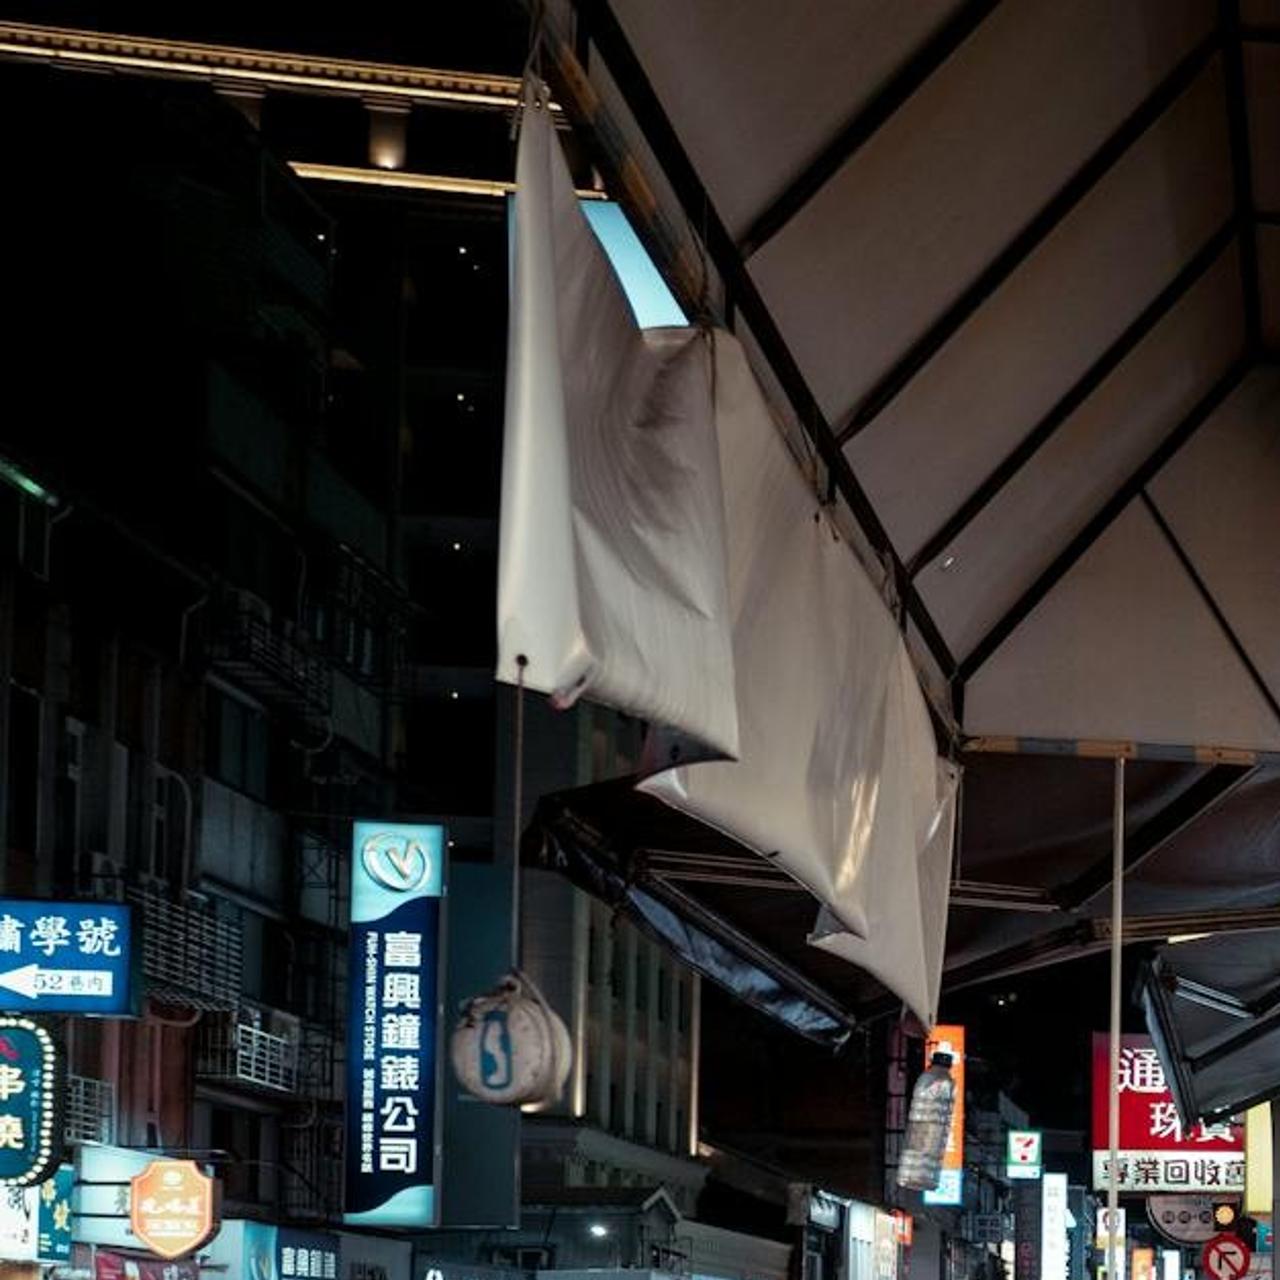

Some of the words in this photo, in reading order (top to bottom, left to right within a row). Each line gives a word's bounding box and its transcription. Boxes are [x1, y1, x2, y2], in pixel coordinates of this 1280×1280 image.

[379, 931, 422, 1173] 富興鐘錶公司
